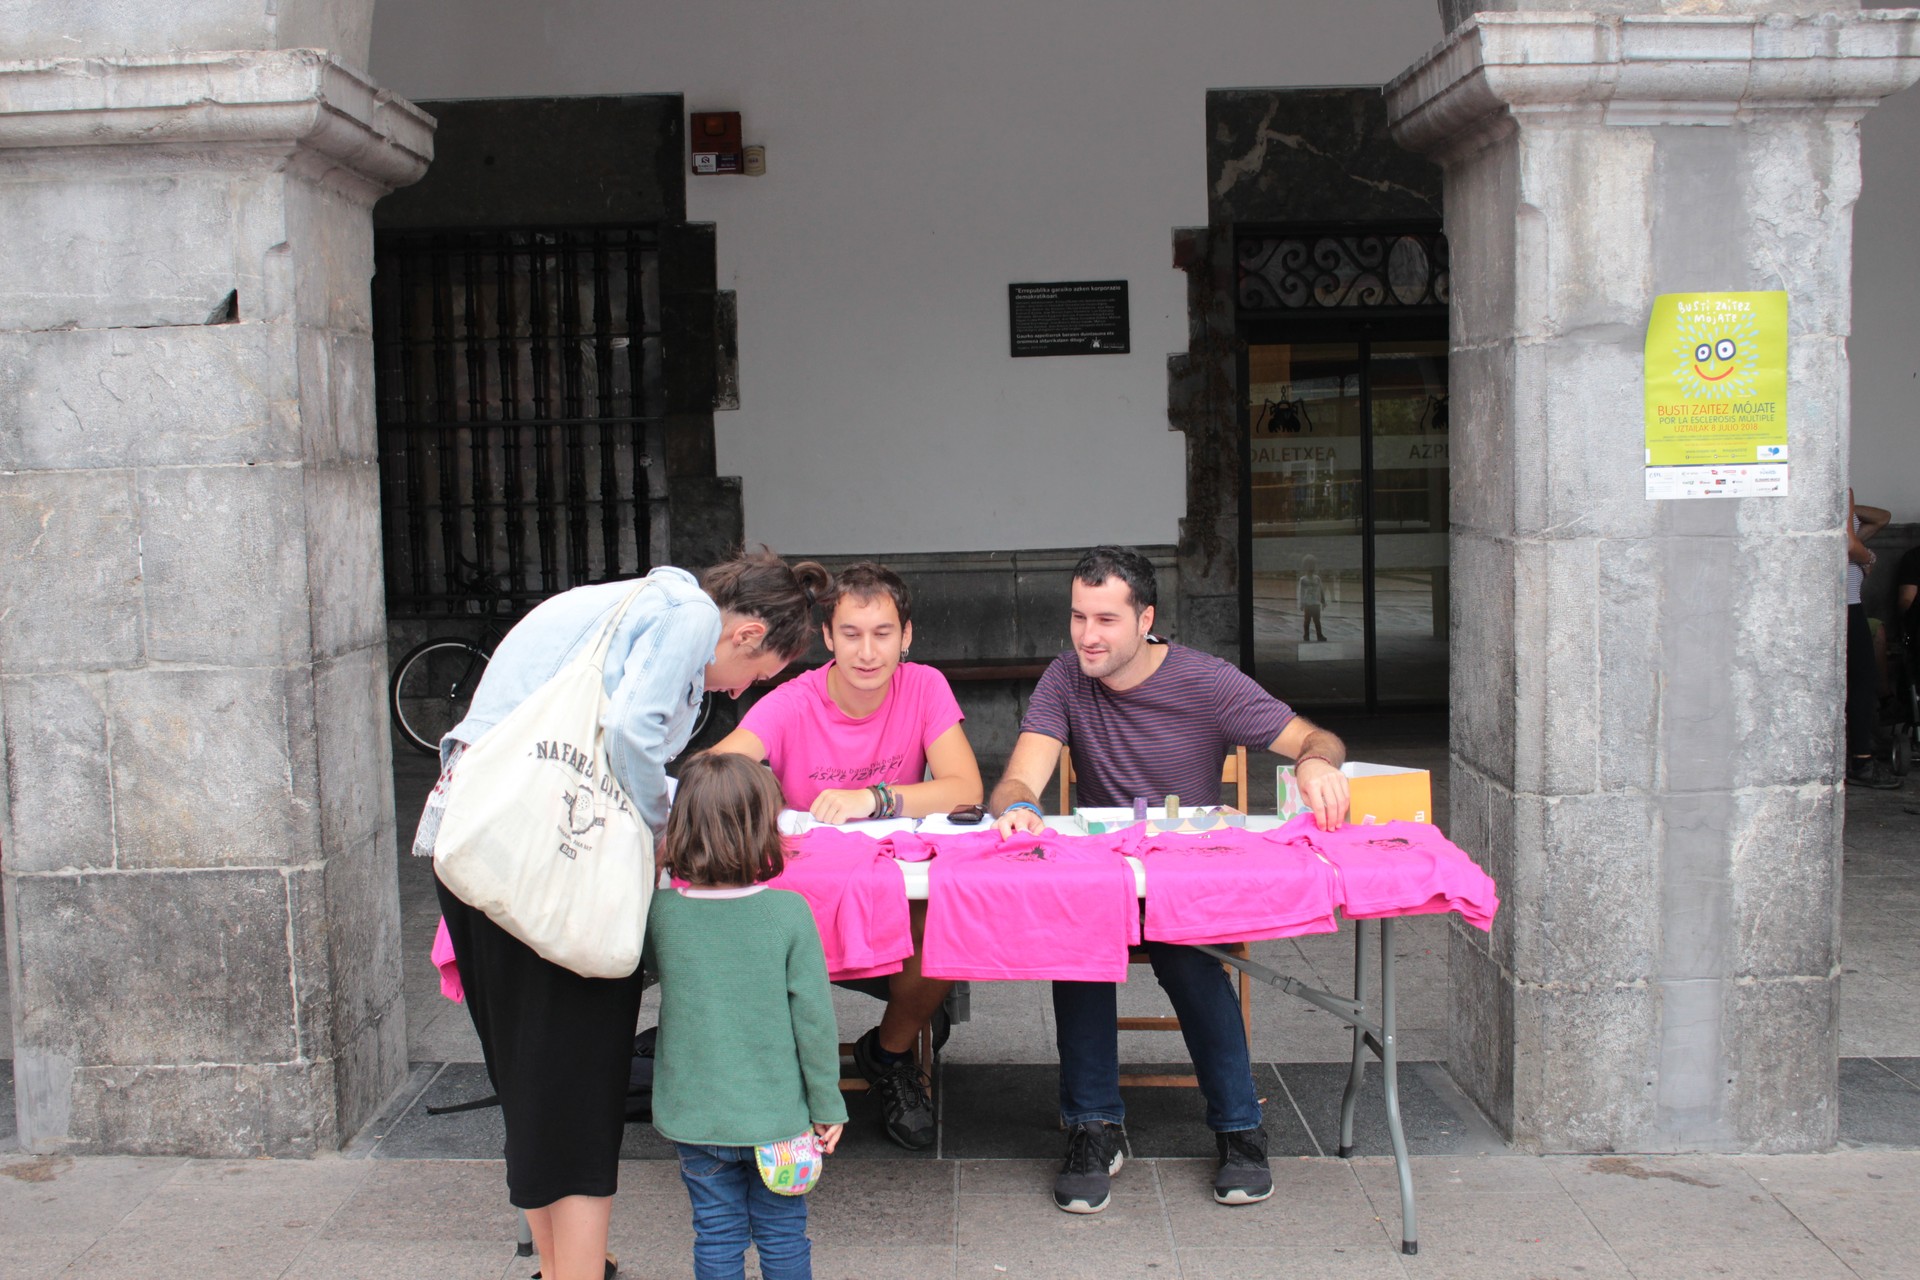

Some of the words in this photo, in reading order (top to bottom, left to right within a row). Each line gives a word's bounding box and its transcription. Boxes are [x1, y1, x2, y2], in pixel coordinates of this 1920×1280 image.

[1657, 404, 1689, 416] BUSTI
[1692, 403, 1729, 415] ZAITEZ
[1732, 401, 1776, 414] MÓJATE
[1659, 416, 1676, 425] POR
[1678, 416, 1688, 424] LA
[1690, 415, 1736, 424] ESCLEROSIS
[1674, 424, 1709, 433] UZTAILAK
[1711, 424, 1716, 432] 8
[1718, 424, 1739, 432] JULIO
[1741, 423, 1758, 431] 2018
[808, 771, 847, 782] ASKE
